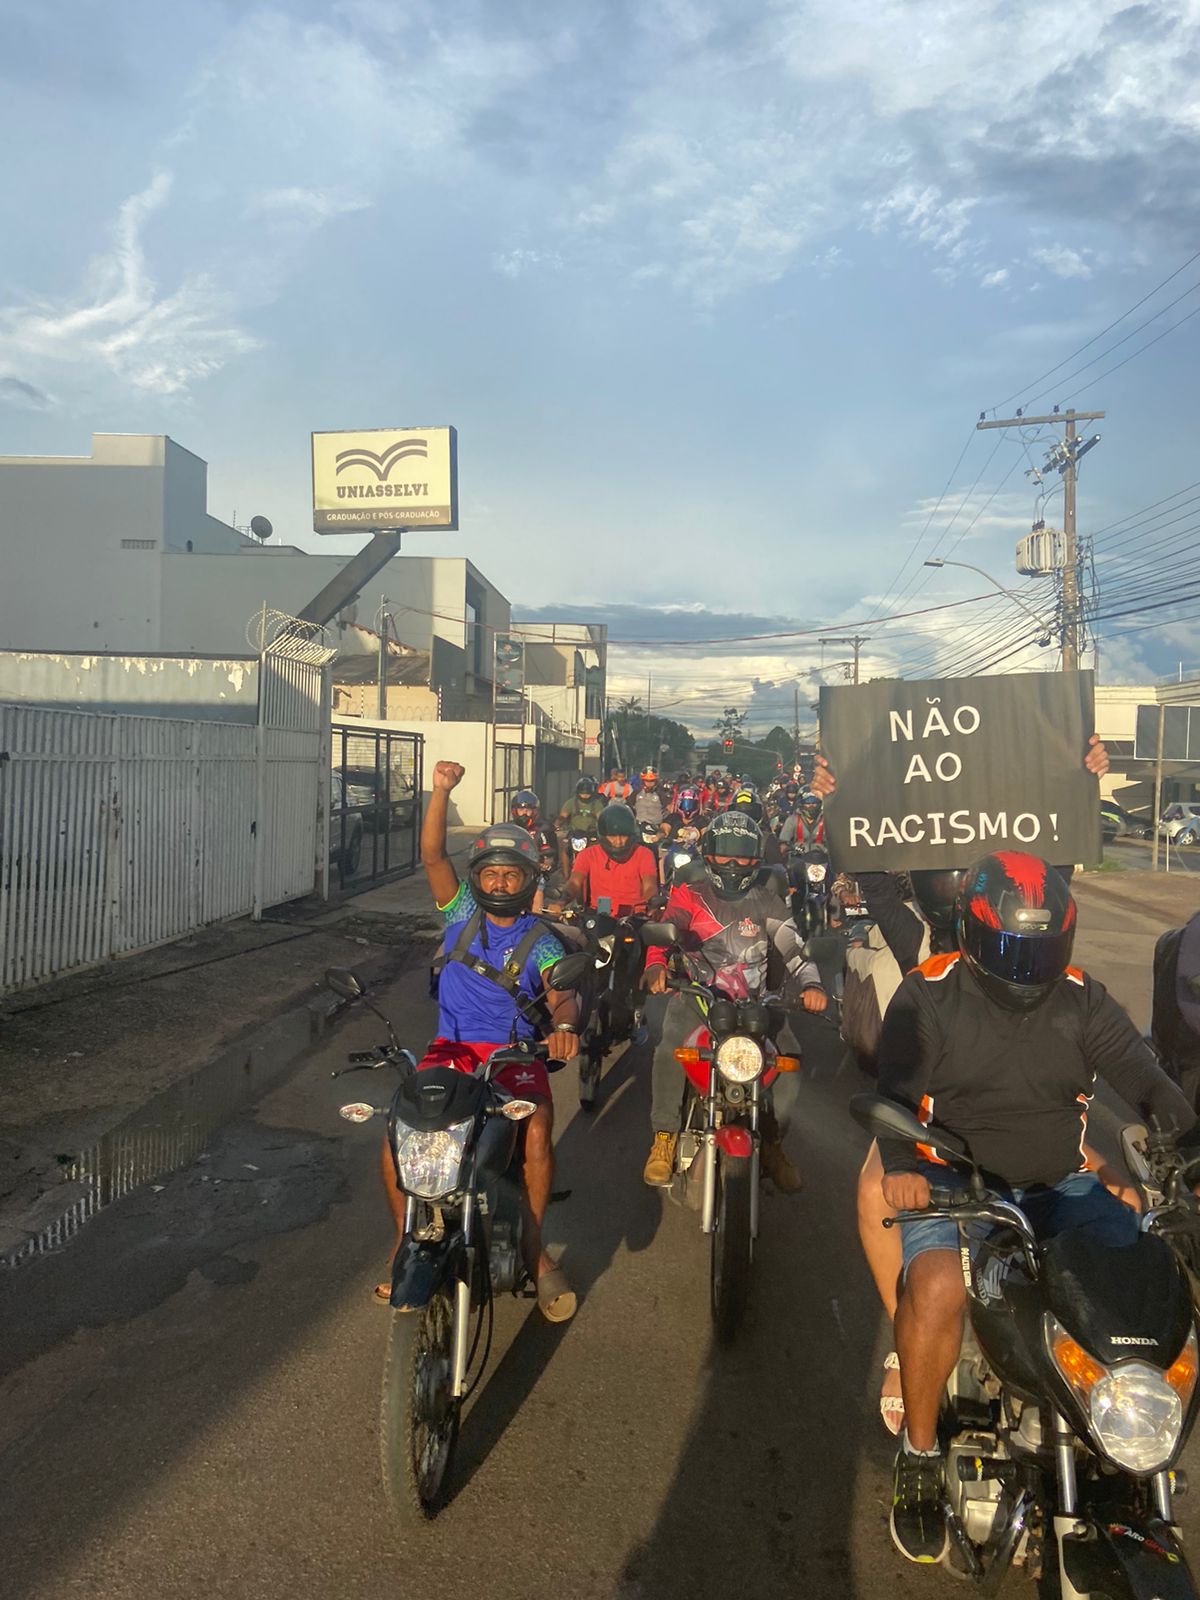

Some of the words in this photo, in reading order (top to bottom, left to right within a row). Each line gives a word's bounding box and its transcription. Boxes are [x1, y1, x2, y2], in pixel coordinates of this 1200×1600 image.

[336, 483, 429, 498] UNIASSELVI
[326, 512, 371, 521] GRADUAÇÃO
[395, 510, 440, 519] GRADUAÇÃO
[889, 697, 981, 742] NÃO
[903, 752, 963, 784] AO
[849, 810, 1059, 847] RACISMO!
[1110, 1336, 1159, 1345] HONDA
[1124, 1529, 1145, 1541] Alto
